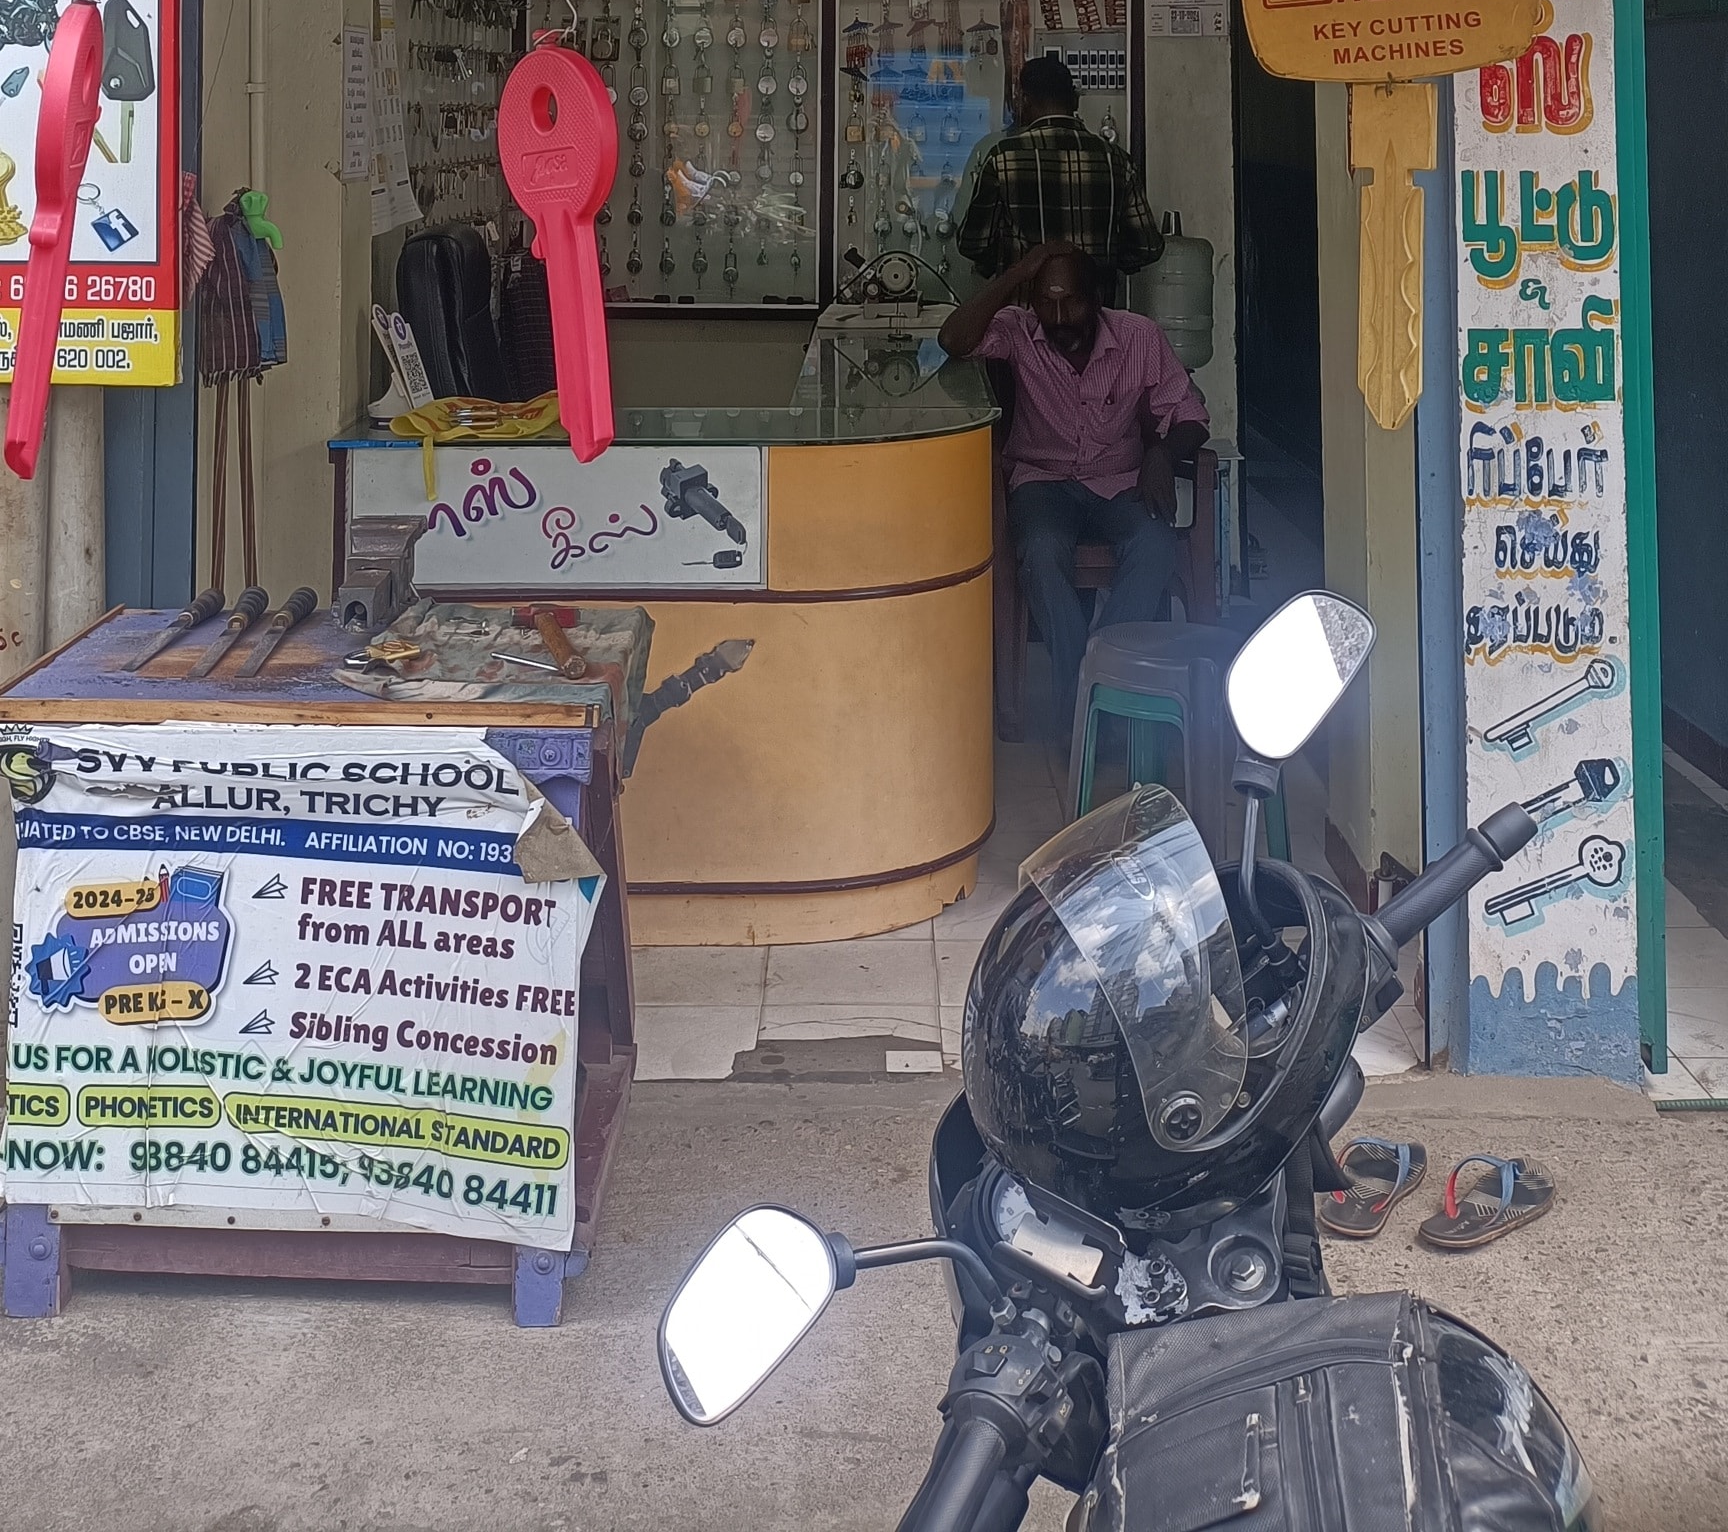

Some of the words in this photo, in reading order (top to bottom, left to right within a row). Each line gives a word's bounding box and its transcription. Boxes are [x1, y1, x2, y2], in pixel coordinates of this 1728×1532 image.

[1313, 21, 1362, 41] KEY
[1369, 11, 1482, 36] CUTTING
[1333, 38, 1465, 65] MACHINES
[1461, 170, 1616, 279] பூட்டு
[86, 276, 155, 301] 26780
[1519, 279, 1551, 310] &
[57, 349, 88, 368] 620
[95, 349, 130, 368] 002.
[1462, 295, 1616, 404] சாவி
[342, 762, 519, 796] SCHOOL
[151, 783, 291, 816] ALLUR,
[300, 790, 446, 817] TRICHY
[80, 826, 109, 840] TO
[113, 824, 170, 843] CBSE,
[175, 825, 223, 842] NEW
[226, 826, 286, 846] DELHI.
[304, 831, 428, 856] AFFILIATION
[437, 840, 476, 860] NO:
[479, 843, 517, 864] 193
[300, 877, 373, 909] FREE
[381, 883, 557, 928] TRANSPORT
[90, 921, 220, 948] ADMISSIONS
[298, 913, 370, 946] from
[377, 919, 427, 949] ALL
[433, 930, 515, 960] areas
[129, 953, 177, 974] OPEN
[104, 993, 144, 1015] PRE
[188, 989, 204, 1010] X
[294, 963, 311, 990] 2
[318, 965, 371, 995] ECA
[377, 969, 509, 1008] Activities
[515, 984, 575, 1016] FREE
[289, 1011, 389, 1052] Sibling
[396, 1019, 557, 1065] Concession
[12, 1045, 49, 1071] US
[56, 1045, 113, 1072] FOR
[121, 1047, 141, 1072] A
[272, 1059, 294, 1081] &
[300, 1057, 406, 1094] JOYFUL
[413, 1070, 553, 1111] LEARNING
[85, 1096, 213, 1119] PHONETICS
[235, 1103, 425, 1139] INTERNATIONAL
[431, 1121, 560, 1159] STANDARD
[8, 1140, 104, 1172] NOW:
[463, 1175, 558, 1216] 84411
